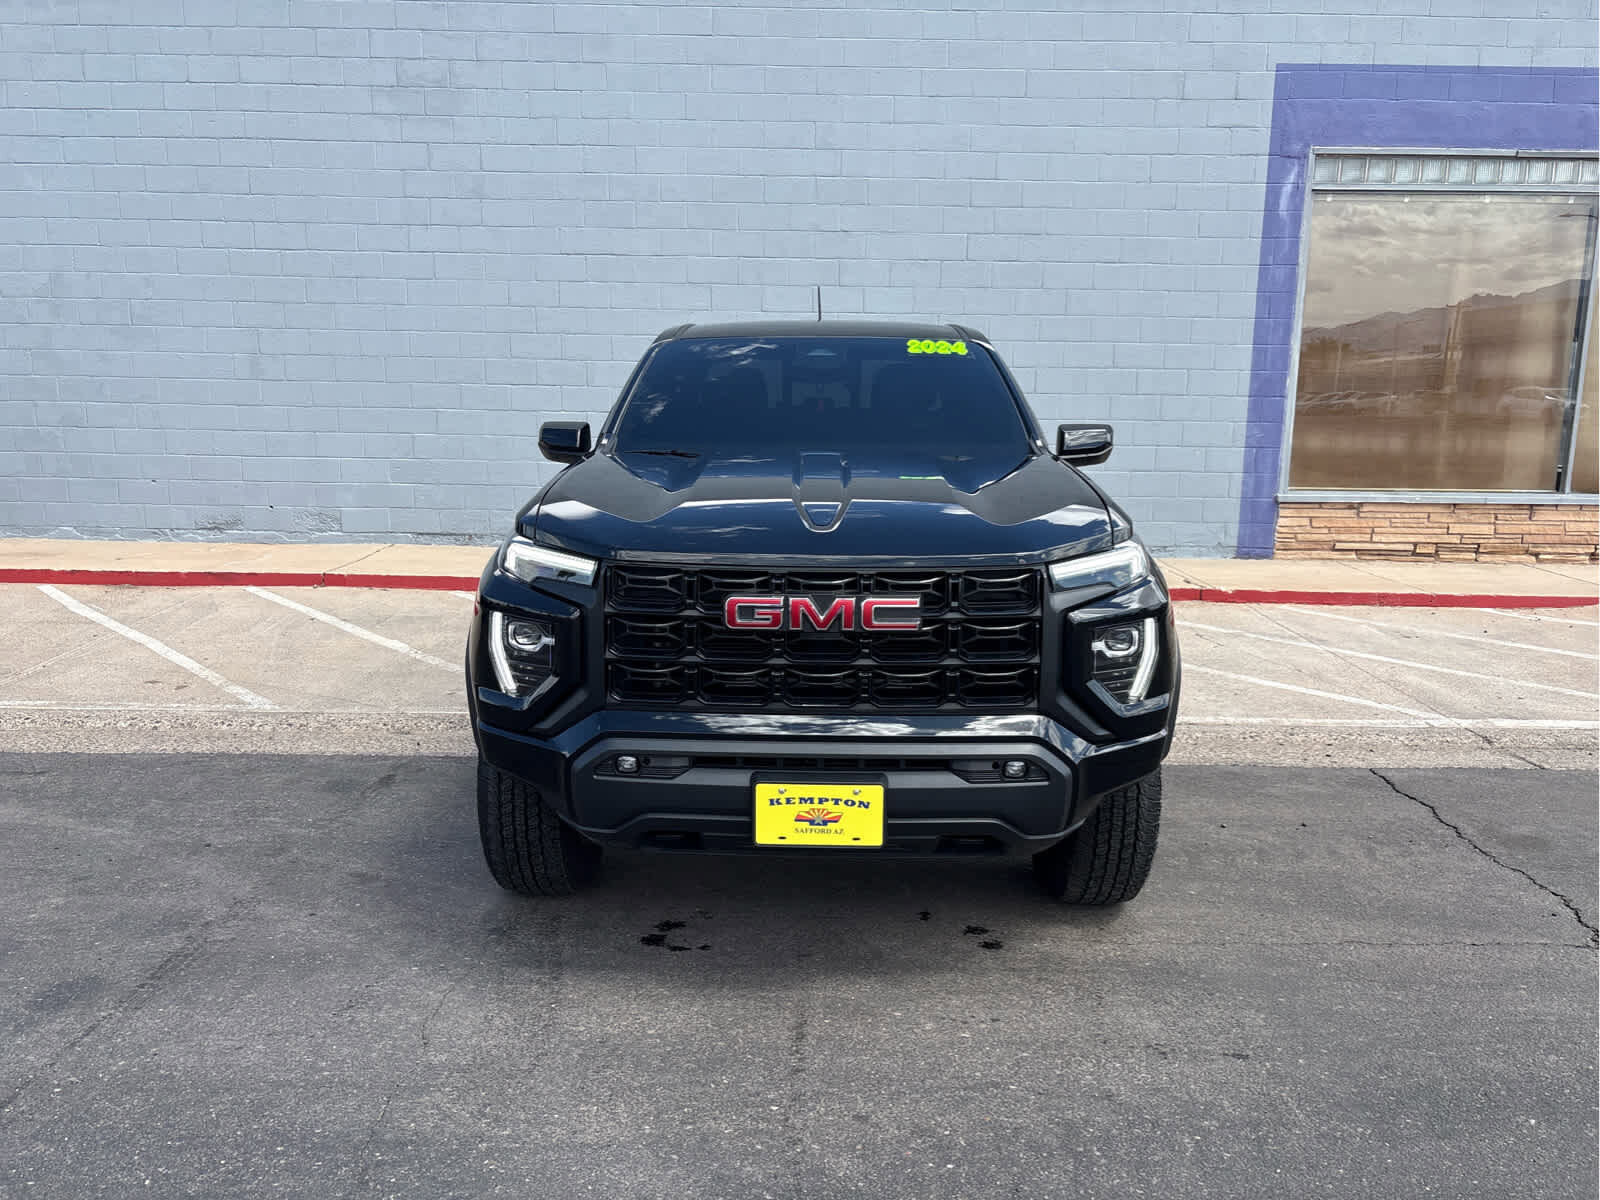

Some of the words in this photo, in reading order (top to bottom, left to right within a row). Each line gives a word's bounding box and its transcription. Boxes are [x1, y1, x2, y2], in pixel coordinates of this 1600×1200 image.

[906, 339, 968, 355] 2024
[725, 596, 920, 631] GMC
[768, 797, 871, 809] KEMPTON
